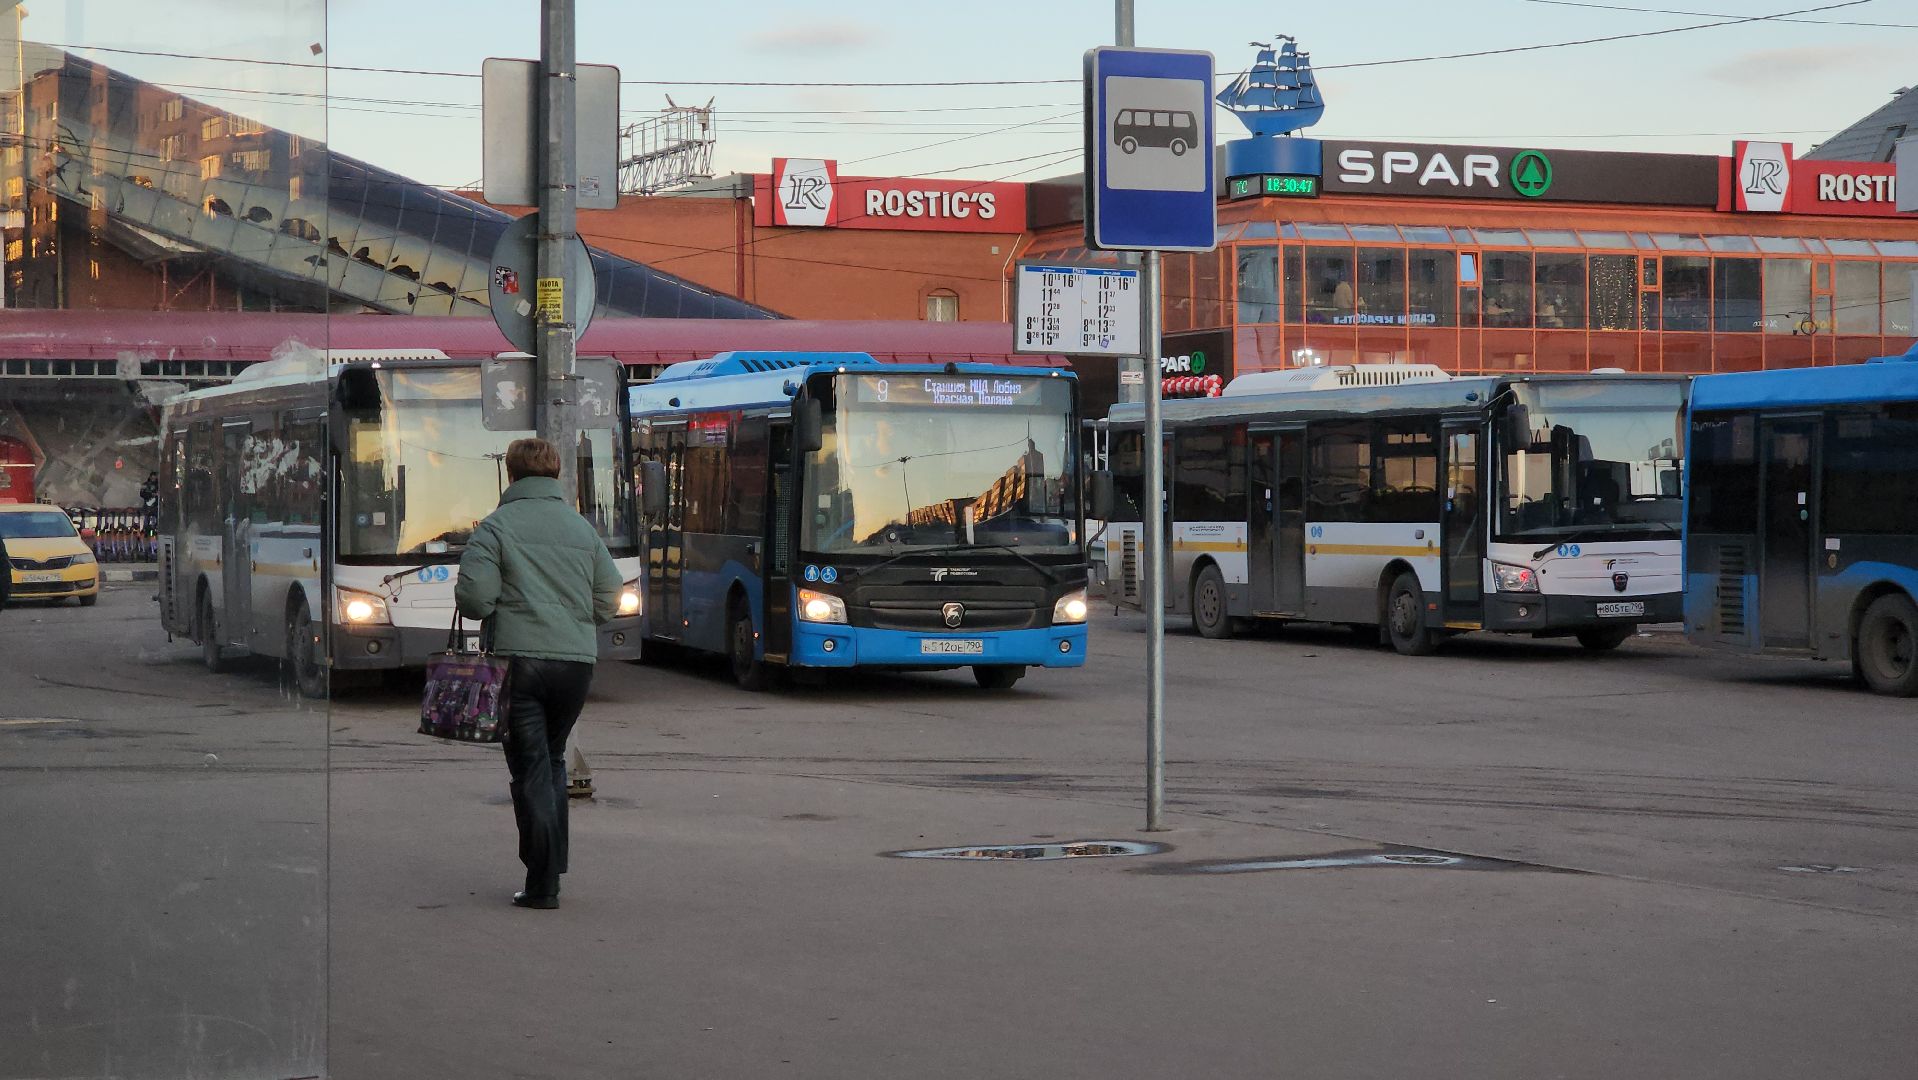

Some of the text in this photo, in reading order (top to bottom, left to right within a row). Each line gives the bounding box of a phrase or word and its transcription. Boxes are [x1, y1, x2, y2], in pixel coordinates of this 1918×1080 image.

[1338, 150, 1500, 188] SPAR
[1746, 158, 1782, 194] R
[785, 175, 826, 210] R
[1266, 177, 1312, 194] 18:30:47
[1819, 174, 1895, 202] ROSTI
[866, 189, 996, 218] ROSTIC'S
[1042, 274, 1052, 286] 10
[1063, 275, 1074, 287] 16
[1099, 276, 1109, 289] 10
[1119, 277, 1128, 290] 16
[1042, 288, 1052, 301] 11
[1099, 291, 1108, 304] 11
[1042, 303, 1052, 316] 12
[1098, 305, 1109, 318] 12
[1026, 317, 1032, 329] 8
[1041, 317, 1052, 330] 13
[1083, 319, 1088, 332] 8
[1098, 320, 1108, 333] 13
[1026, 331, 1032, 344] 9
[1041, 332, 1052, 345] 15
[1083, 334, 1088, 346] 9
[1098, 334, 1109, 346] 1
[1161, 356, 1190, 373] PAR
[877, 379, 888, 402] 9
[992, 380, 1021, 394] Лобня
[934, 390, 1013, 405] Красная Поляна
